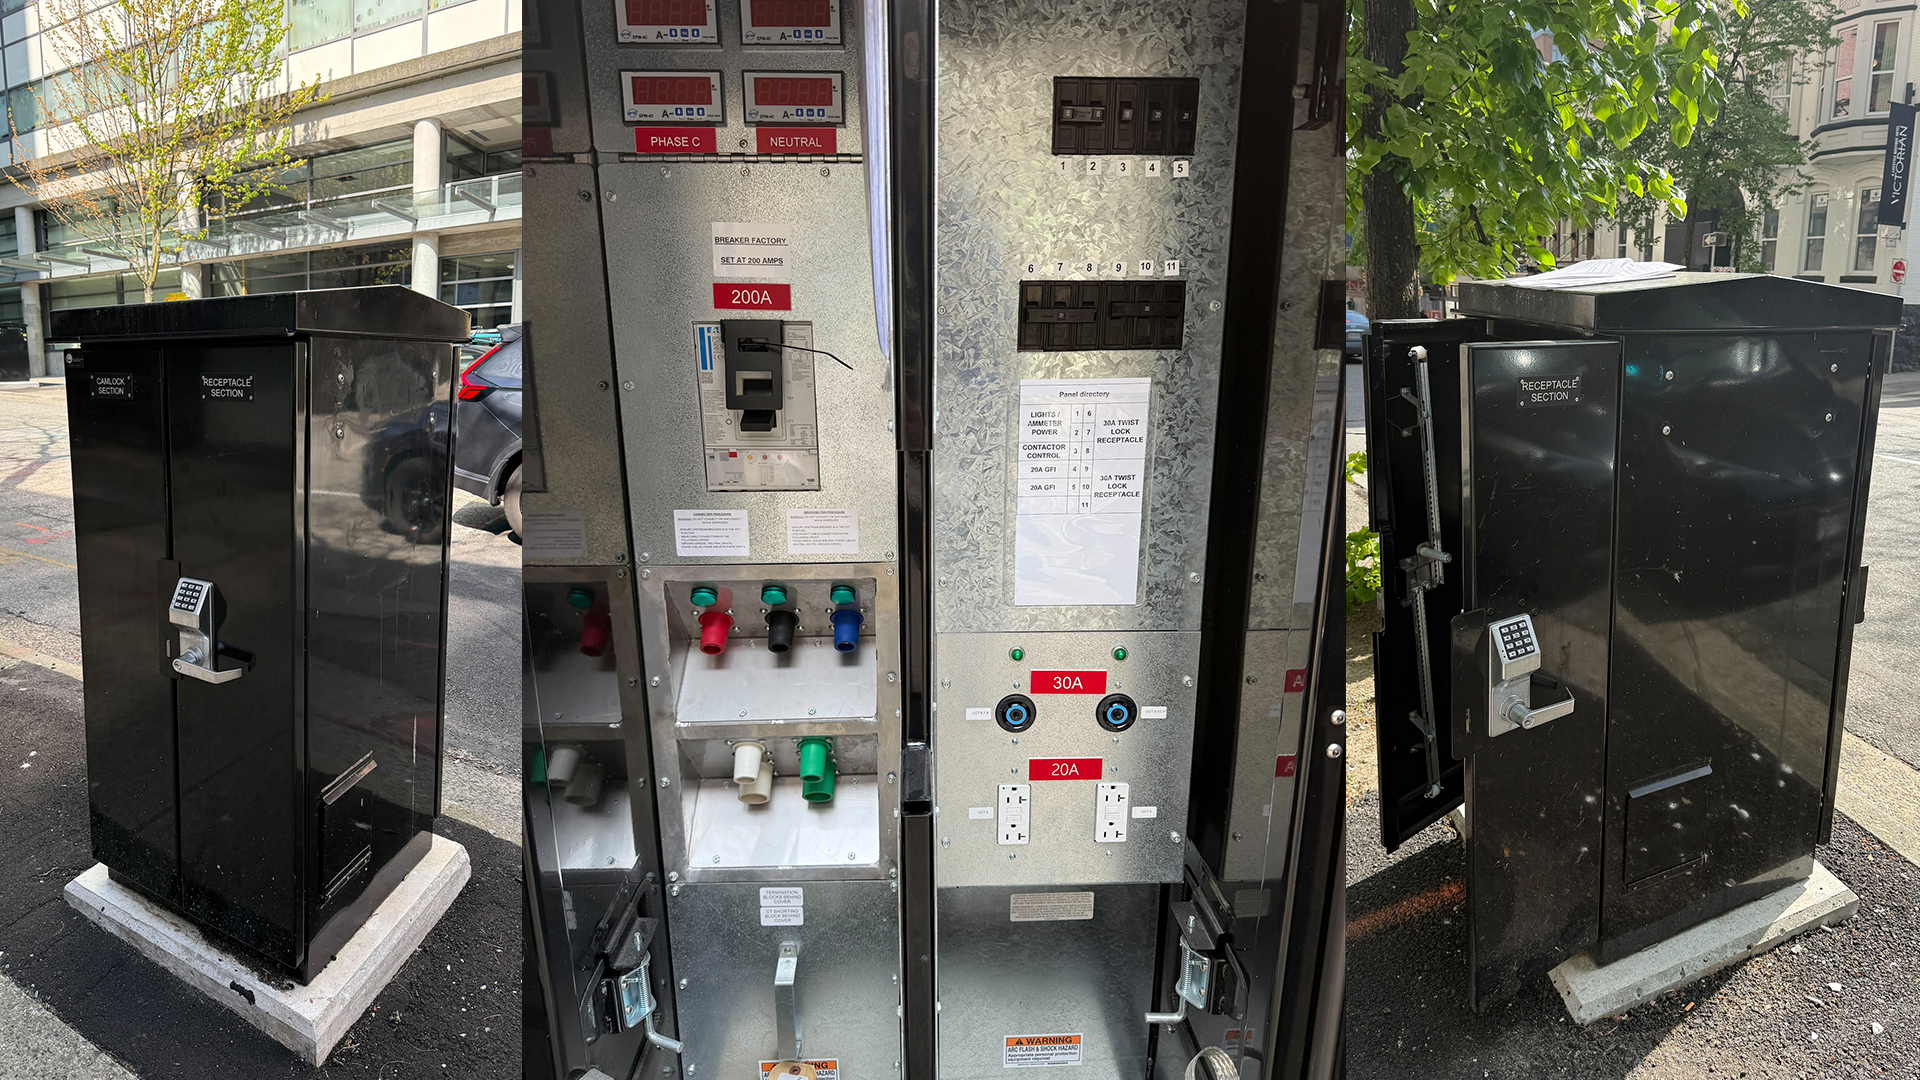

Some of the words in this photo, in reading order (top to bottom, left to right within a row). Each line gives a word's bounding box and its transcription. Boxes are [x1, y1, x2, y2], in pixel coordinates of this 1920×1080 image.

[650, 137, 689, 147] PHASE
[691, 137, 701, 147] C
[770, 137, 822, 147] NEUTRAL
[1060, 162, 1065, 170] 1
[1090, 162, 1096, 170] 2
[1120, 163, 1126, 171] 3
[1149, 163, 1155, 172] 4
[1177, 164, 1183, 173] 5
[1890, 125, 1908, 205] VICTORIAN
[1028, 264, 1034, 273] 6
[1057, 263, 1063, 271] 7
[1086, 263, 1092, 272] 8
[1115, 263, 1122, 272] 9
[1140, 262, 1151, 271] 10
[1166, 262, 1176, 271] 11
[731, 289, 772, 304] 200A
[96, 377, 125, 385] CAMLOCK
[203, 378, 251, 386] RECEPTACLE
[1522, 379, 1577, 391] RECEPTACLE
[98, 387, 124, 395] SECTION
[210, 389, 244, 398] SECTION
[1079, 391, 1110, 399] directory
[1531, 392, 1569, 402] SECTION
[1053, 676, 1083, 690] 30A
[1051, 763, 1079, 776] 20A
[1026, 1036, 1072, 1045] WARNING
